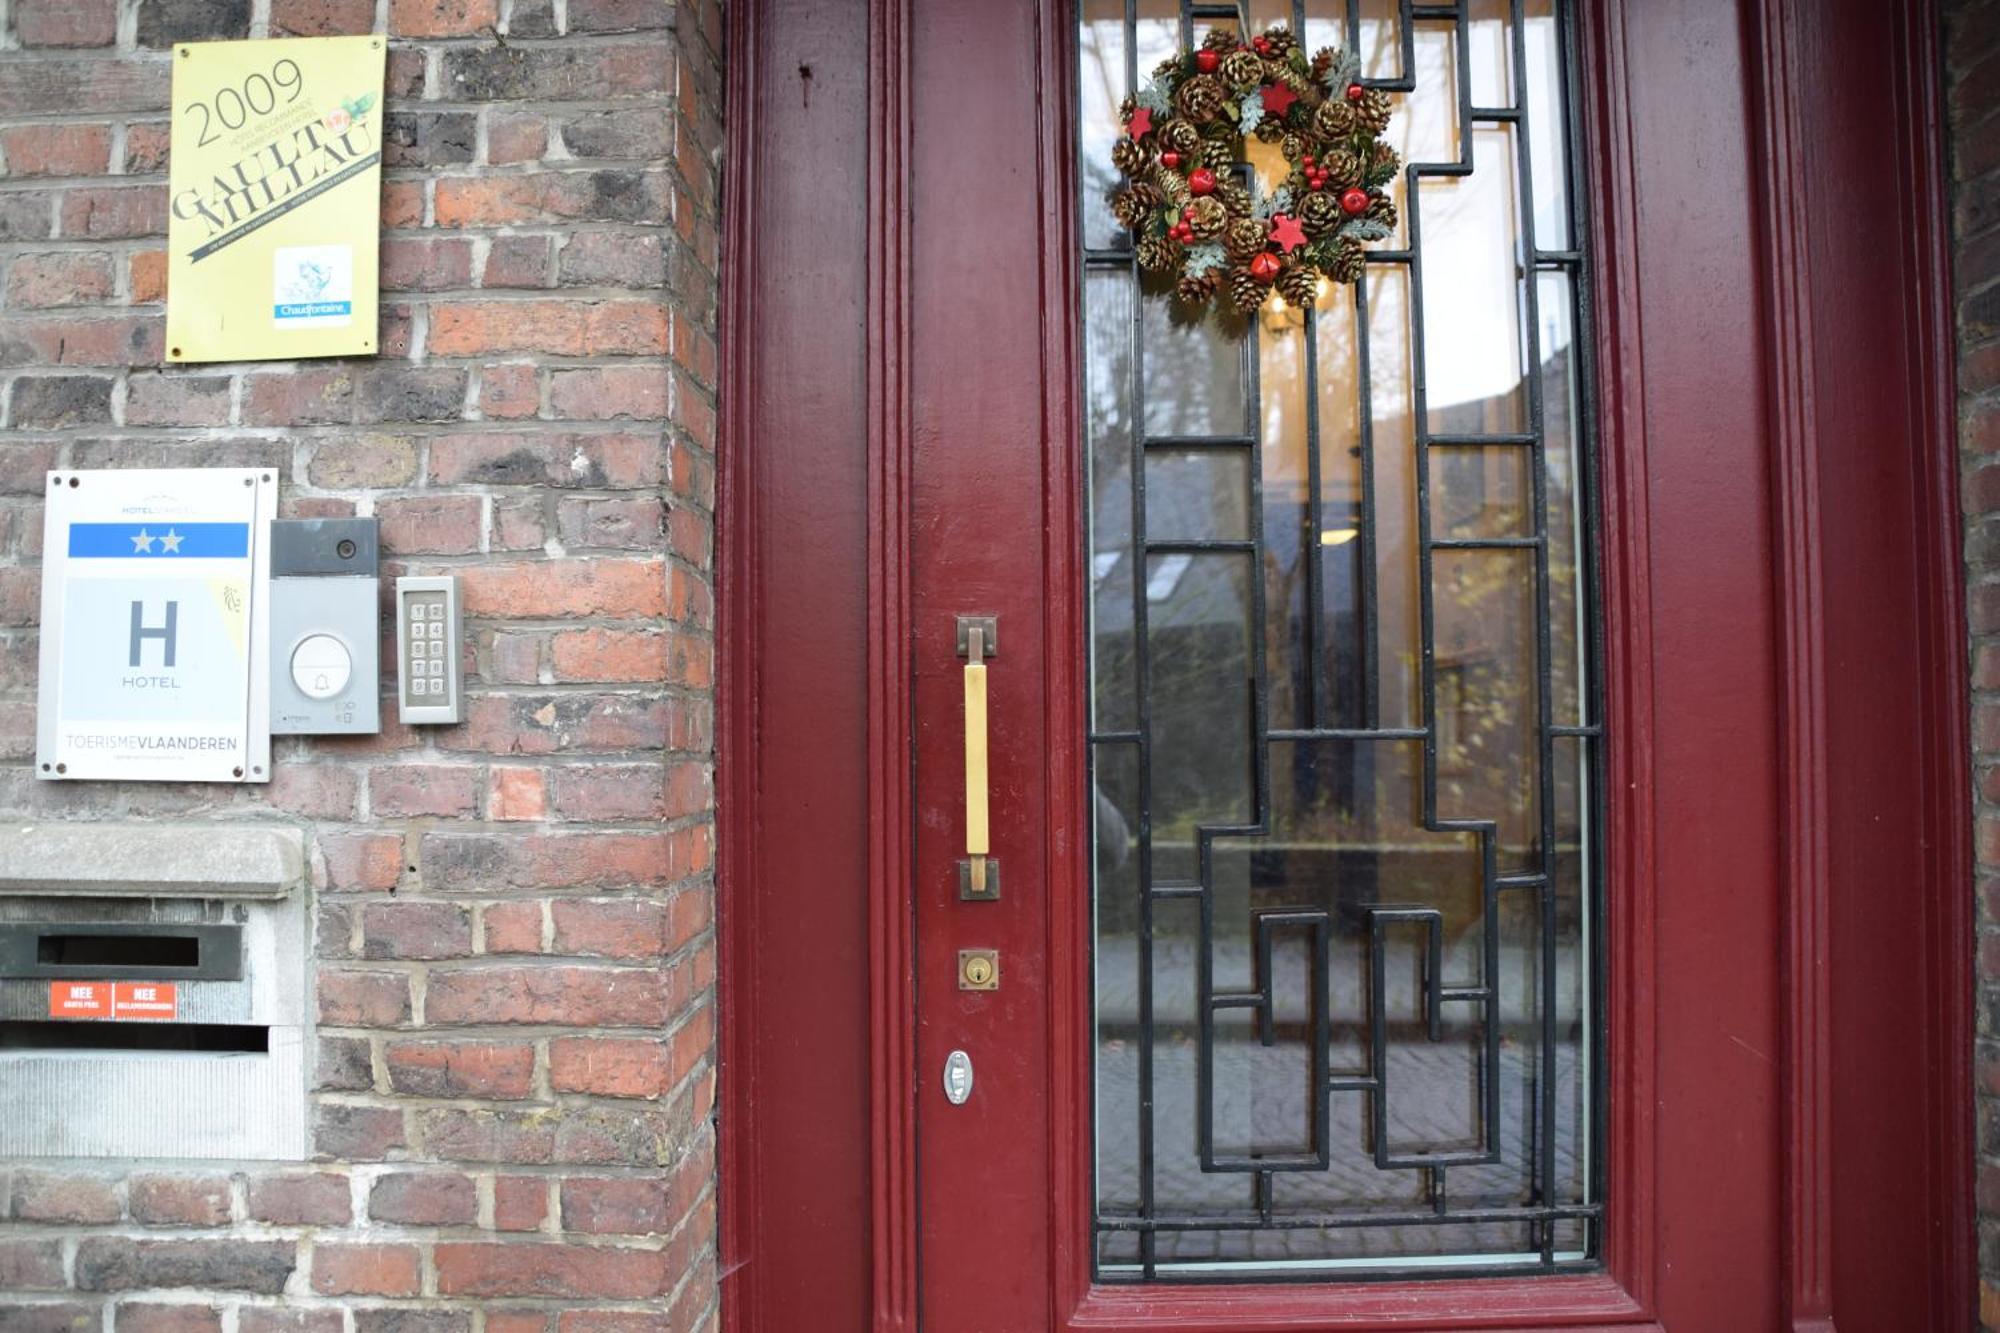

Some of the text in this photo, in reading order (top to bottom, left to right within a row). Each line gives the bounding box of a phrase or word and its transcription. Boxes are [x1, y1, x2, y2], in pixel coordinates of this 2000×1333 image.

[184, 58, 303, 148] 2009
[172, 118, 326, 220] GAULT
[193, 122, 373, 236] MILLAU
[128, 600, 178, 667] H
[122, 676, 181, 689] HOTEL
[65, 735, 238, 751] TOERISMEVLAANDEREN
[70, 986, 93, 999] NEE
[134, 988, 158, 1001] NEE
